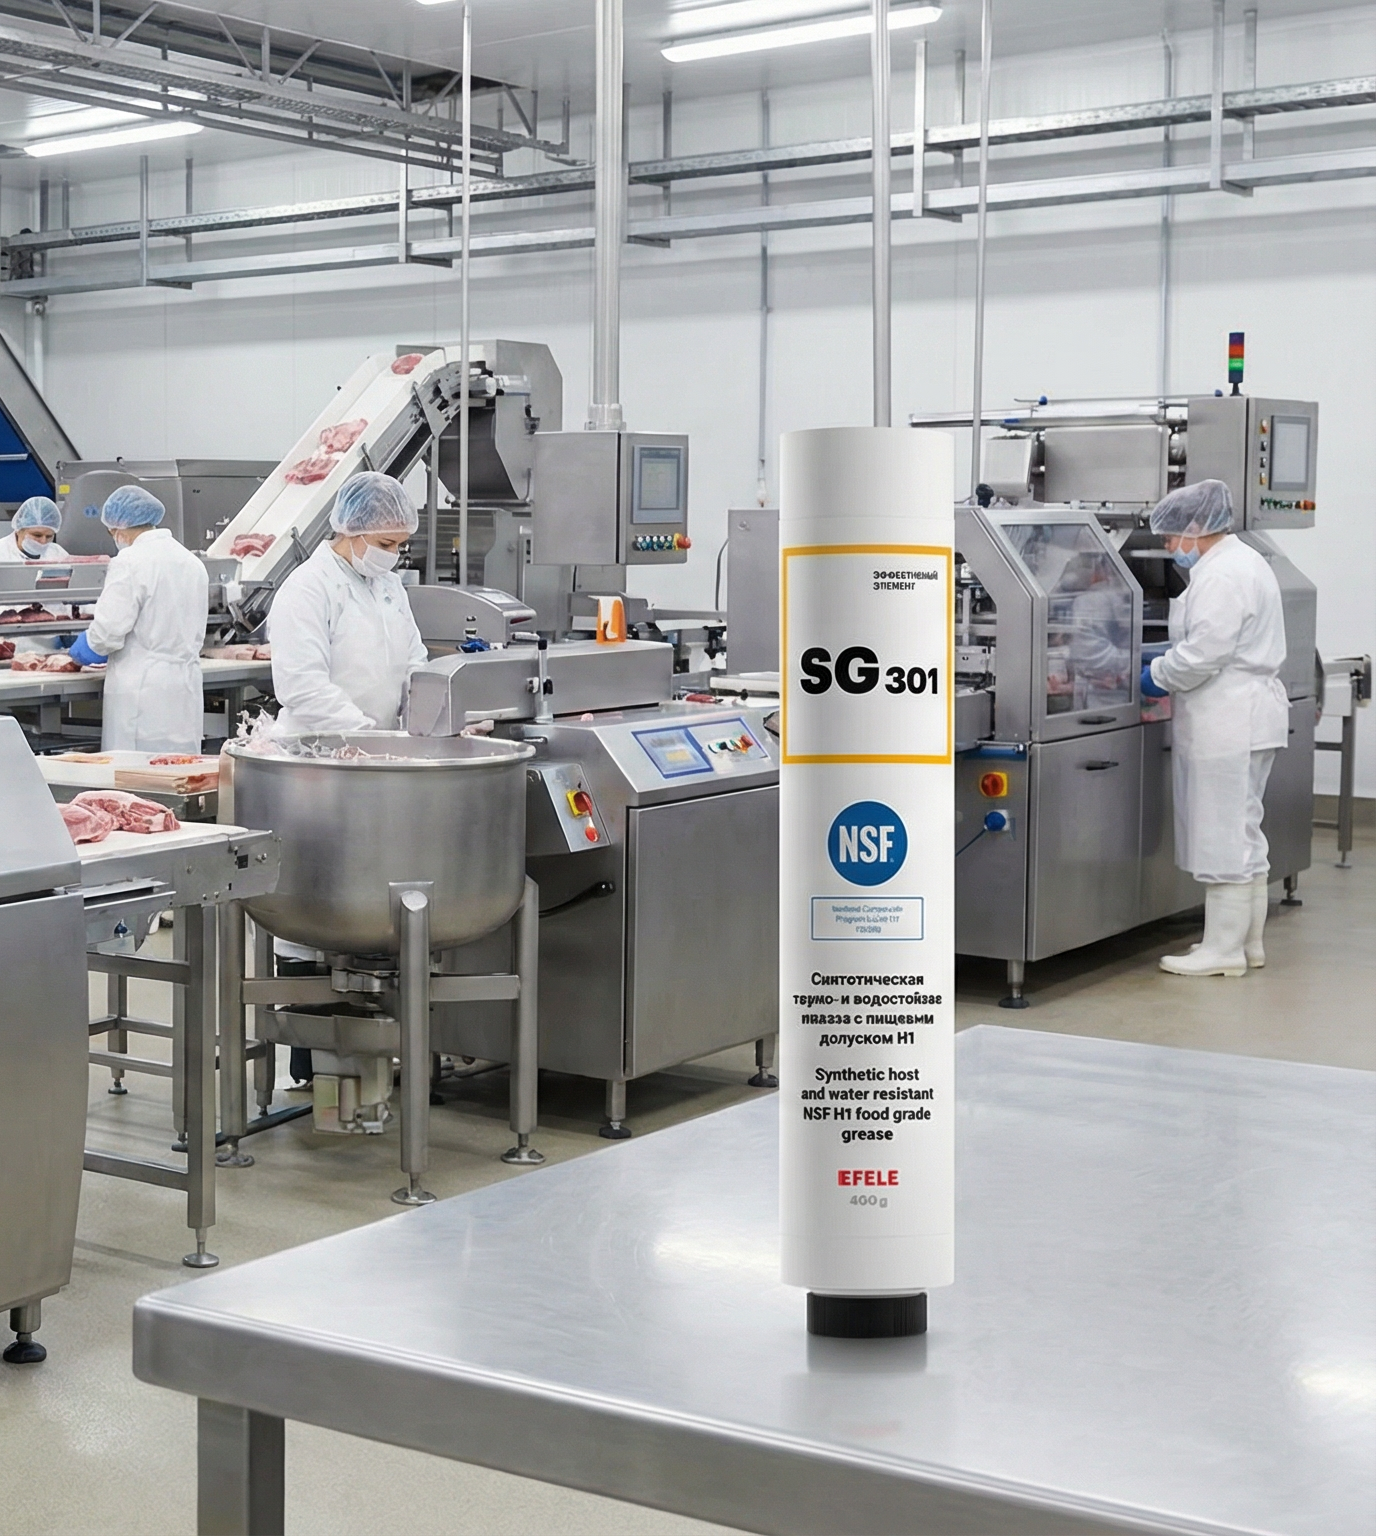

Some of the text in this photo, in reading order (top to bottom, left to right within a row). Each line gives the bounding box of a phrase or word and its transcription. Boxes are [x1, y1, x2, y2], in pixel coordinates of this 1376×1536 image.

[800, 646, 938, 695] SG 301
[838, 825, 895, 863] NSF
[853, 1014, 863, 1025] с
[814, 1066, 920, 1085] Synthetic host
[800, 1086, 934, 1101] and water resistant
[803, 1105, 932, 1125] NSF H1 food grade
[841, 1129, 894, 1144] grease
[837, 1169, 899, 1187] EFELE
